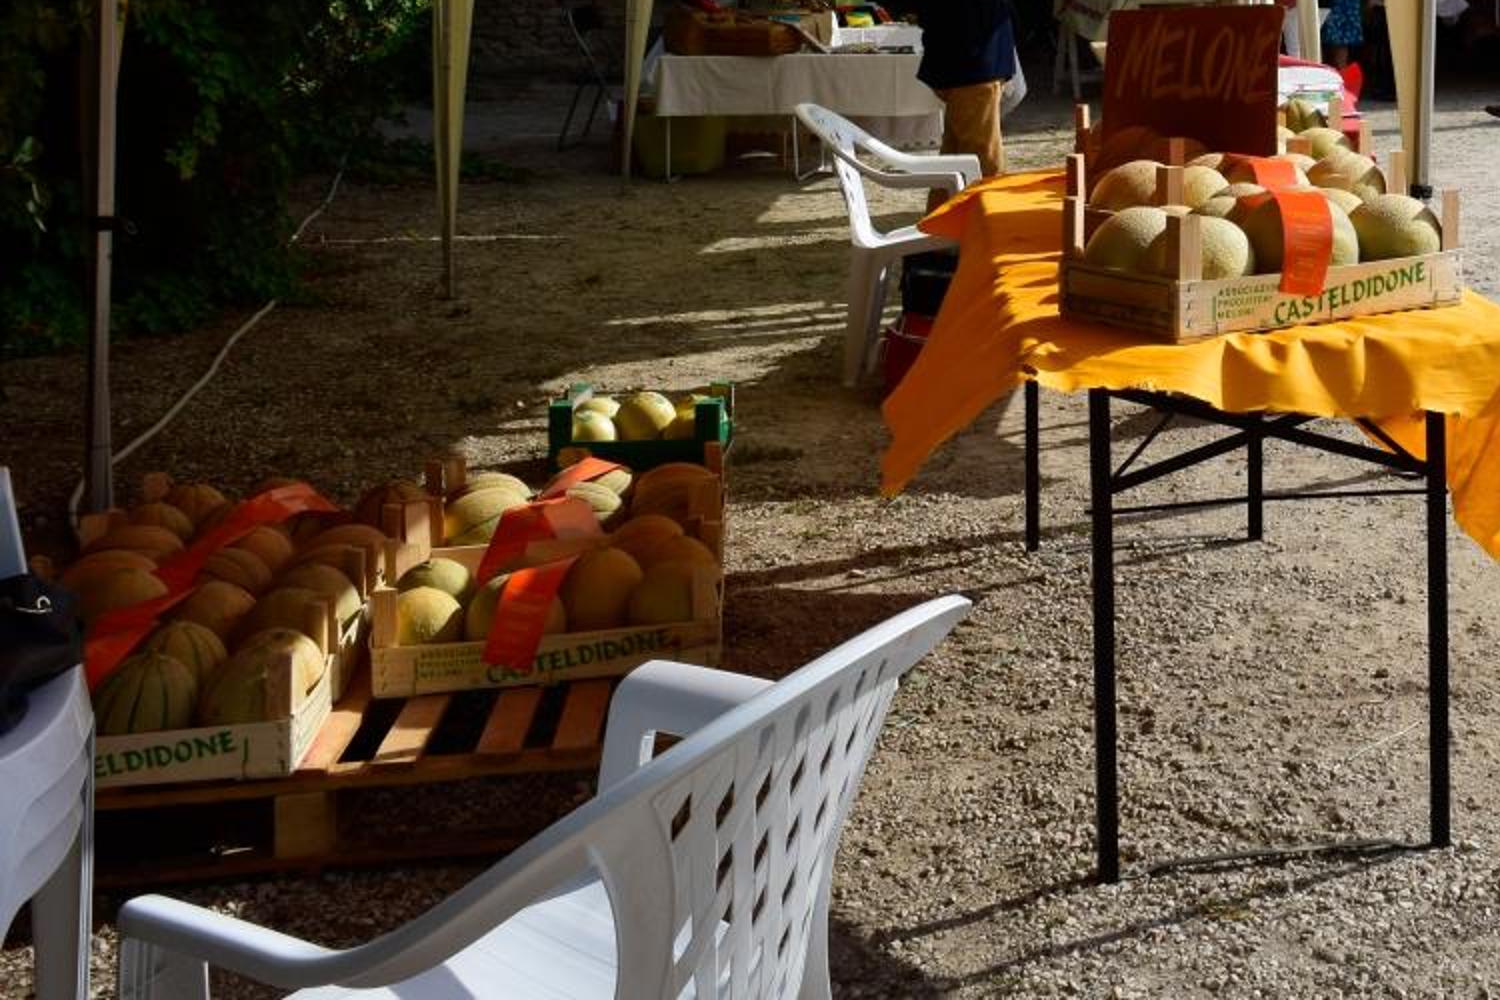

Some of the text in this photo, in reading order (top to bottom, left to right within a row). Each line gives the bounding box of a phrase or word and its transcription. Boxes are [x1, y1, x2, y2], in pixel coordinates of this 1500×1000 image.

[1115, 14, 1276, 104] MELONE
[1274, 261, 1426, 325] CASTELDIDONE
[486, 629, 674, 683] CATELDIDONE
[94, 729, 237, 778] ELDIDONE
